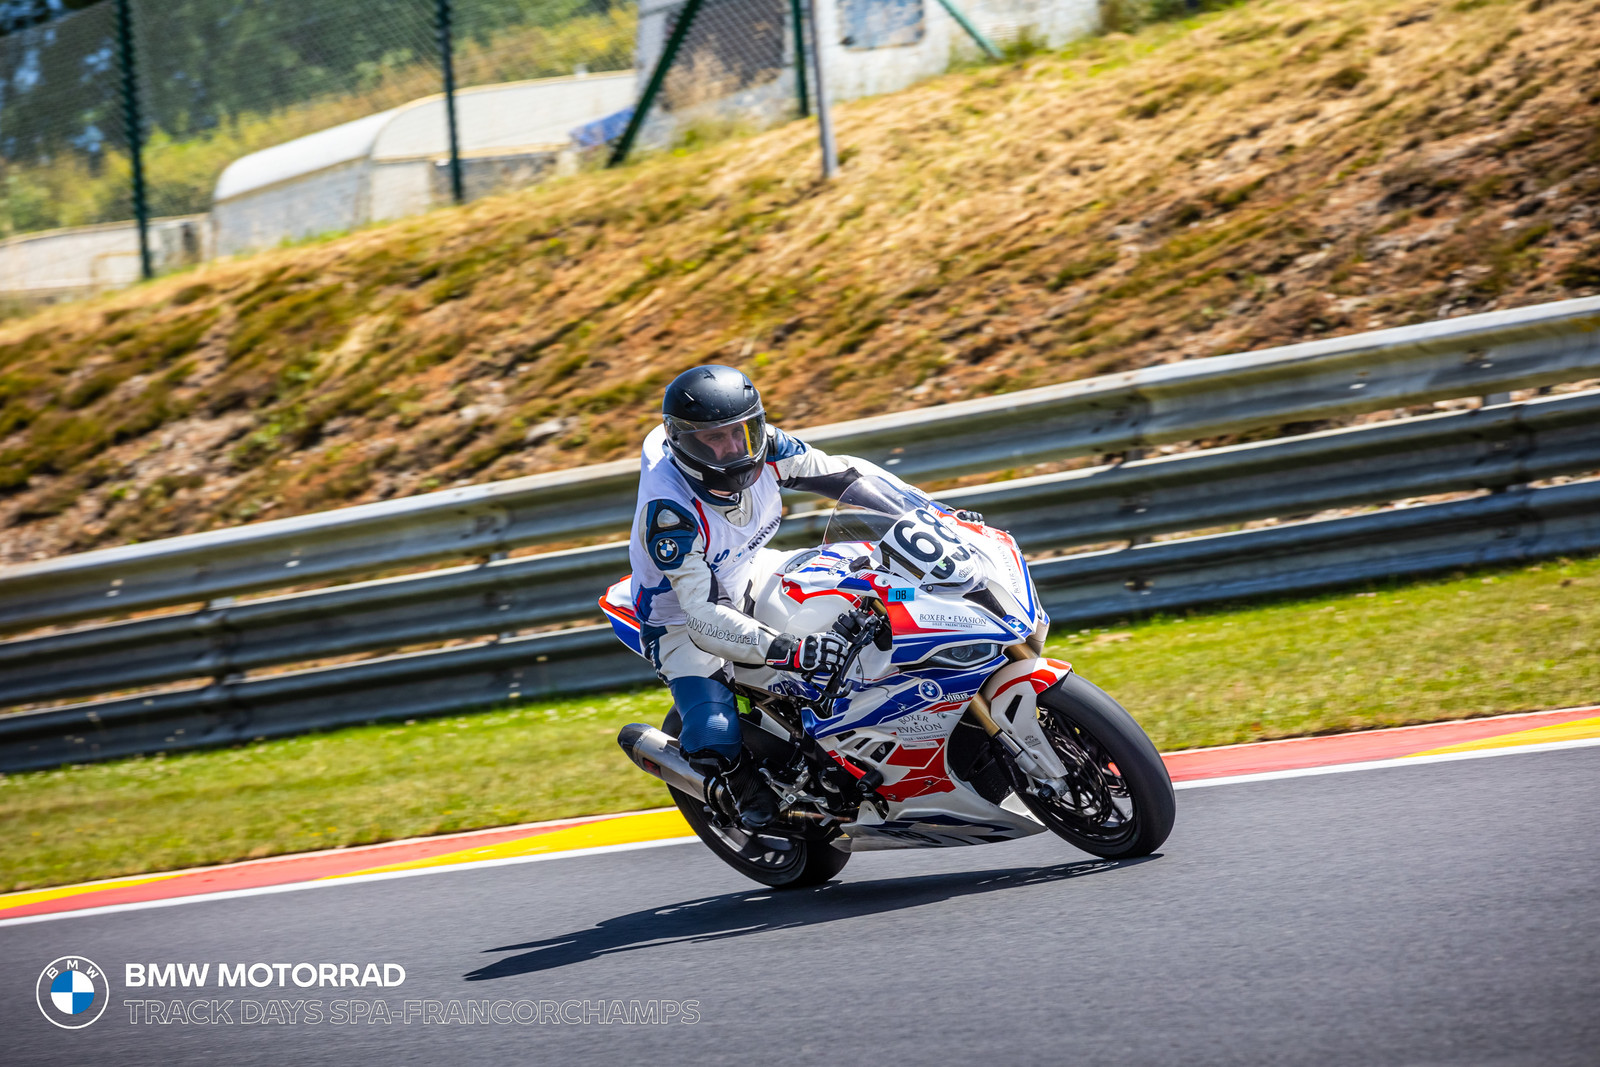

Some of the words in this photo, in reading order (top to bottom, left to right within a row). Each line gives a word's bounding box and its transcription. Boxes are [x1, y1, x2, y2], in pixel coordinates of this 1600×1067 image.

[659, 539, 676, 548] BMW
[878, 509, 961, 580] 168
[919, 613, 946, 622] BOXER
[953, 615, 987, 625] EVASION
[705, 623, 761, 646] Motorrad
[898, 714, 929, 725] BOXER
[897, 722, 943, 733] EVASION
